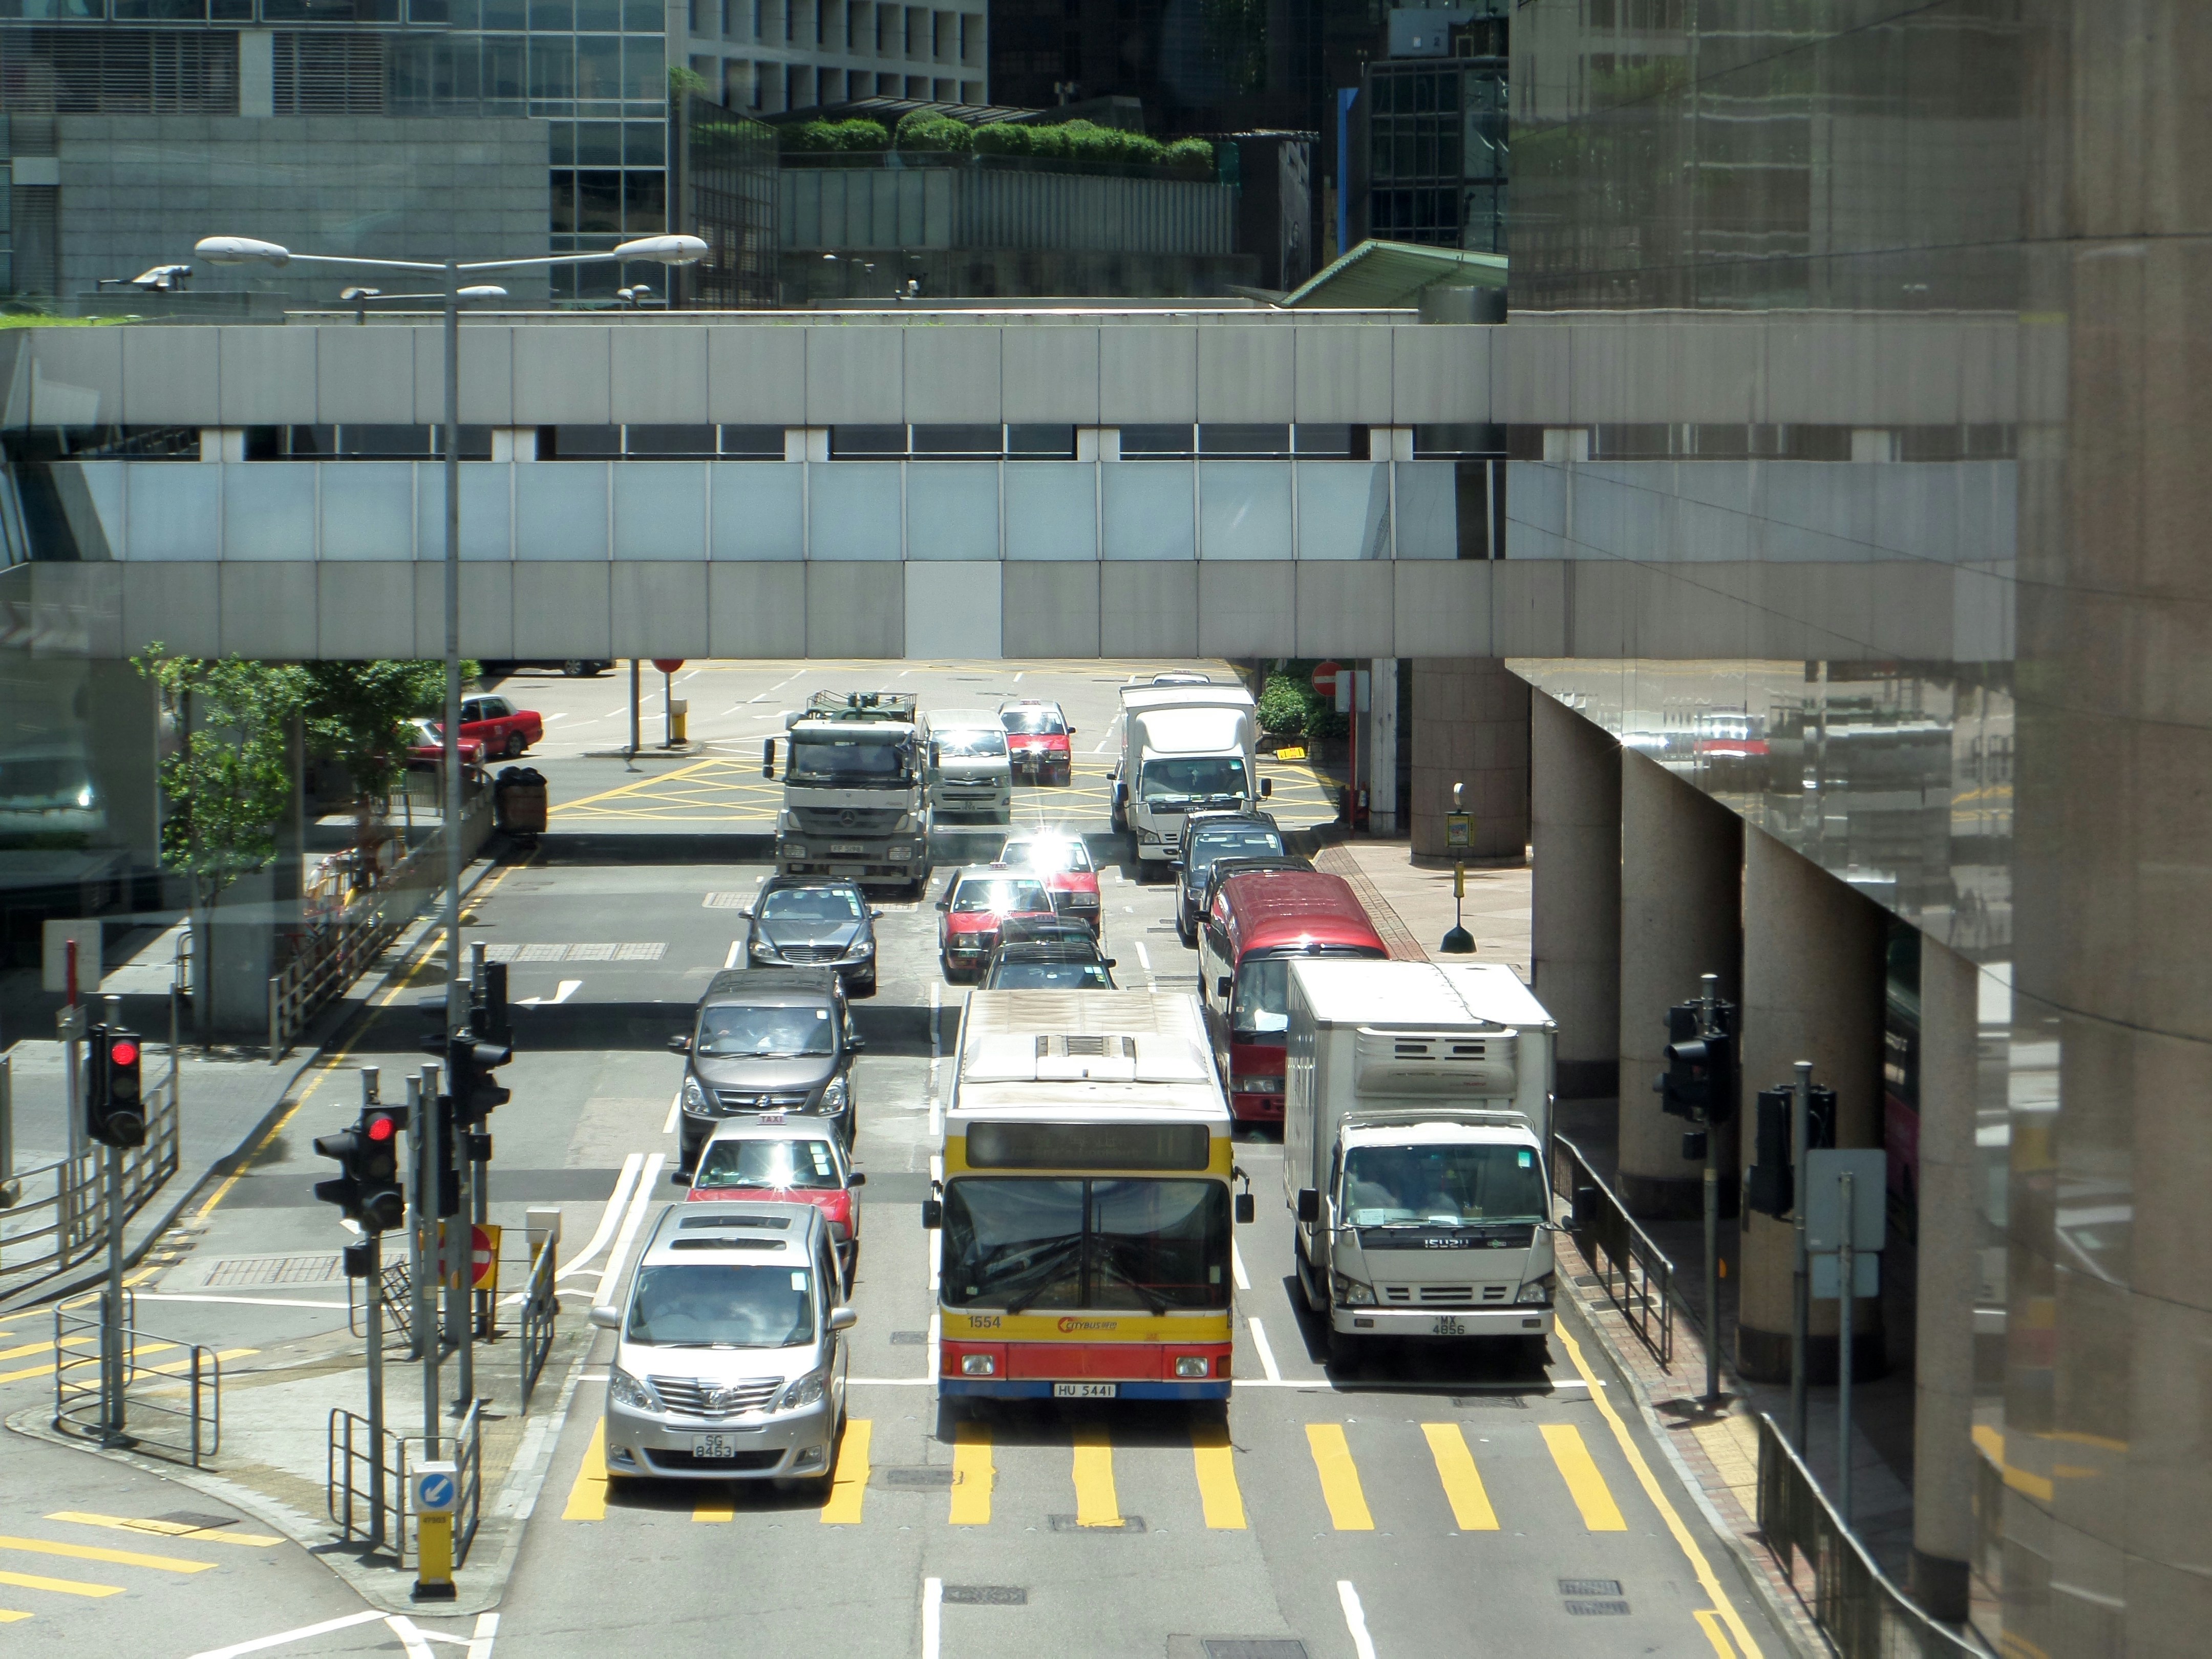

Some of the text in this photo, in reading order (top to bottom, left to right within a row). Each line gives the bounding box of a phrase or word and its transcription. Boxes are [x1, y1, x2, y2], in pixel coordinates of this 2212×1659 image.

[1424, 1239, 1469, 1248] ISUZU
[968, 1315, 1002, 1328] 1554
[1440, 1315, 1456, 1325] MX
[1433, 1325, 1465, 1335] 4856
[1058, 1385, 1111, 1396] HU 5441
[705, 1435, 722, 1445] SG
[696, 1445, 732, 1457] 8463
